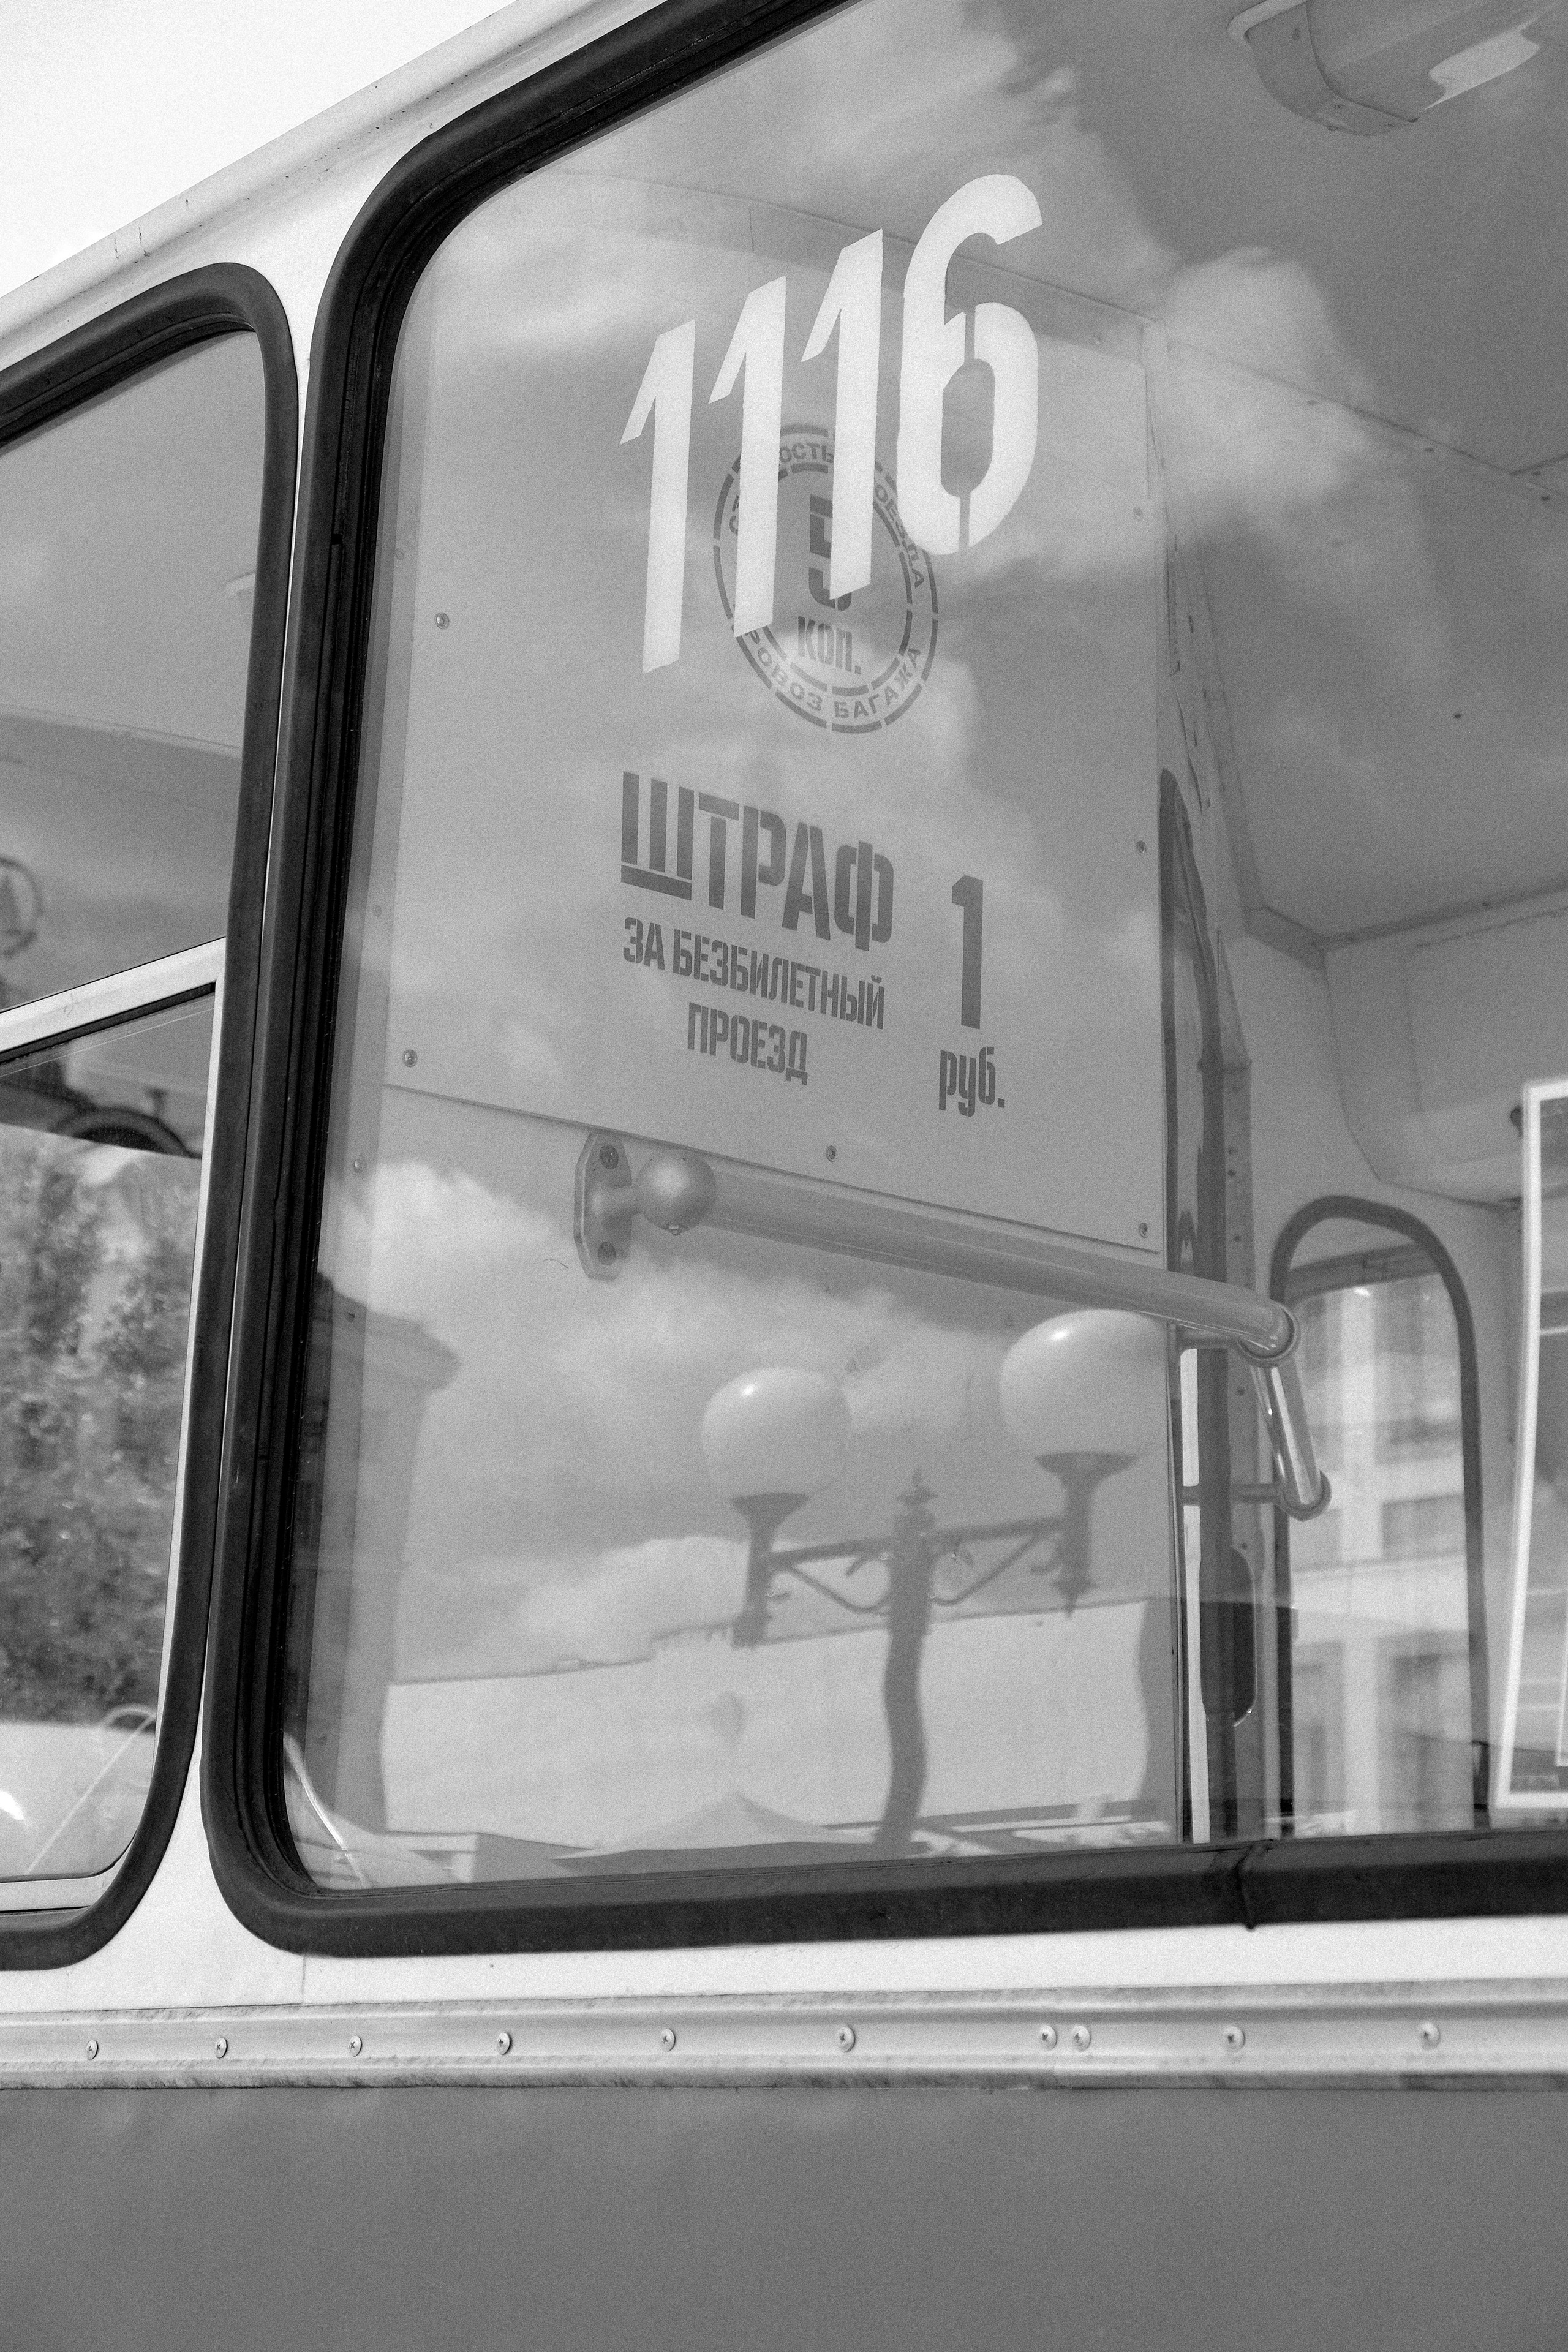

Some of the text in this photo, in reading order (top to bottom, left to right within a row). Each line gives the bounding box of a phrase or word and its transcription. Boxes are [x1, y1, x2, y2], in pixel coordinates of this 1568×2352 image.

[619, 173, 1043, 674] 1116
[834, 648, 921, 718] БАГАЖА
[620, 771, 894, 951] ШТРАФ
[623, 916, 884, 1030] ЗА БЕЗБИЛЕТНЫЙ
[951, 874, 983, 1030] 1
[687, 1002, 808, 1086] ПРОЕЗД
[938, 1046, 1005, 1117] руб.
